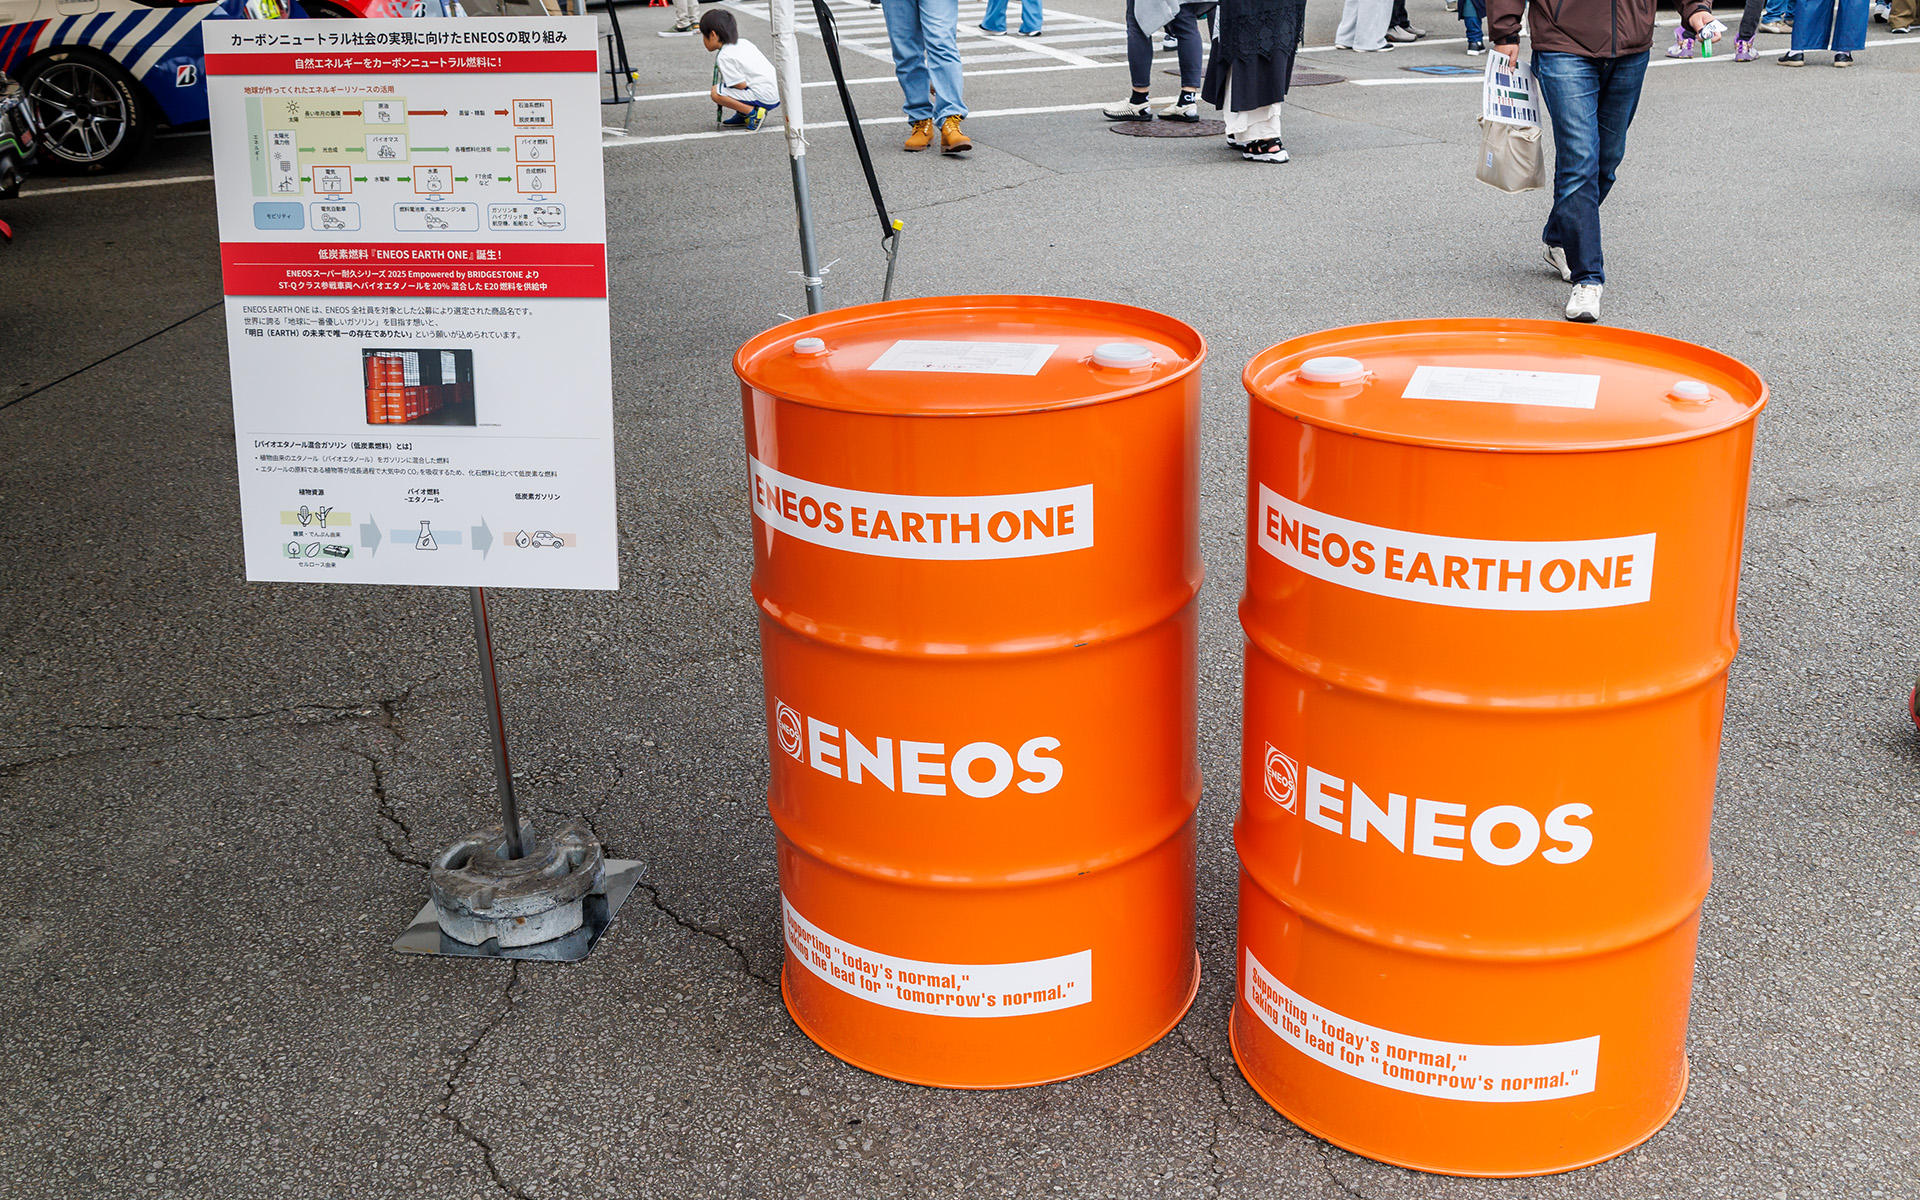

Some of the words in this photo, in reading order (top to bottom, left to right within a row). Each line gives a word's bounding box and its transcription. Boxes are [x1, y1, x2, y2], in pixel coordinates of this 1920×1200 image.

[231, 31, 567, 46] カーボンニュートラル社会の実現に向けたENEOSの取り組み
[295, 57, 502, 69] 自然エネルギーをカーボンニュートラル燃料に！
[244, 85, 395, 94] 地球が作ってくれたエネルギーリソースの活用
[388, 270, 406, 278] 2025
[408, 270, 454, 280] Empowered
[456, 270, 466, 280] by
[467, 271, 523, 279] BRIDGESTONE
[525, 271, 539, 279] より
[412, 250, 445, 260] EARTH
[243, 306, 267, 314] ENEOS
[269, 306, 293, 314] EARTH
[294, 306, 310, 314] ONE
[755, 473, 844, 534] ENEOS
[850, 506, 980, 544] EARTH
[987, 504, 1075, 543] ONE
[1266, 504, 1376, 576] ENEOS
[1384, 546, 1531, 593] EARTH
[1539, 554, 1635, 593] ONE
[778, 718, 800, 742] ENEOS
[807, 715, 1064, 798] ENEOS
[1267, 766, 1294, 791] ENEOS
[1305, 765, 1593, 866] ENEOS
[786, 908, 831, 960] Supporting
[898, 970, 969, 992] normal,"
[787, 926, 809, 961] taking
[811, 952, 827, 971] the
[831, 961, 855, 986] lead
[860, 974, 882, 993] for
[1003, 981, 1075, 1007] normal."
[1251, 985, 1279, 1026] taking
[1281, 1015, 1301, 1039] the
[1305, 1028, 1335, 1057] lead
[1340, 1044, 1365, 1067] for
[1500, 1069, 1579, 1091] normal."
[1252, 967, 1308, 1026] Supporting
[1386, 1044, 1467, 1072] normal,"
